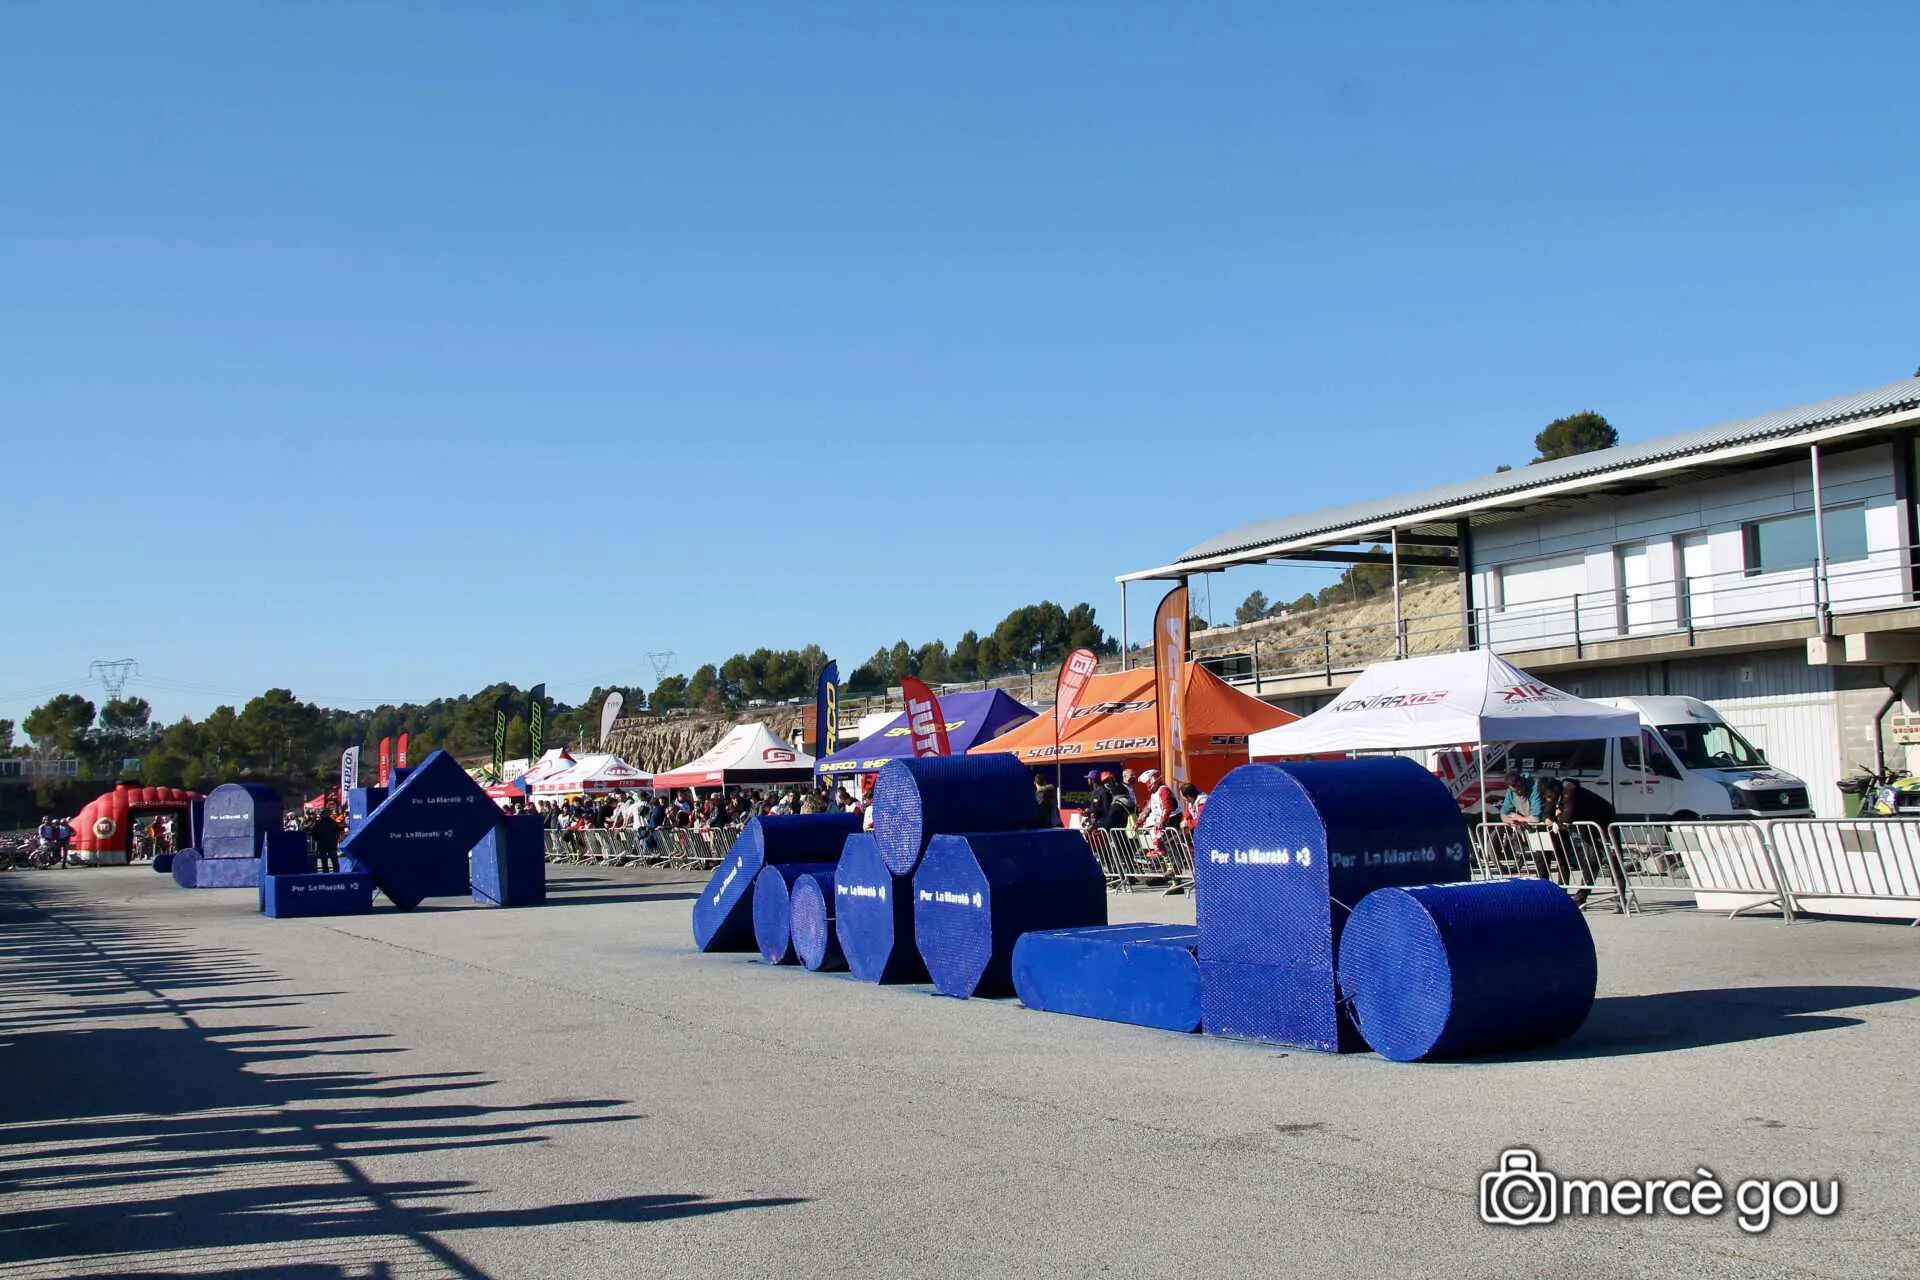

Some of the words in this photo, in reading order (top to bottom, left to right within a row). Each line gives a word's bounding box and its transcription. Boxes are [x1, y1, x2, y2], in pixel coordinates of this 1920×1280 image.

[910, 697, 940, 758] JUT
[1029, 743, 1082, 757] SCORPA
[1096, 736, 1157, 752] SCORPA
